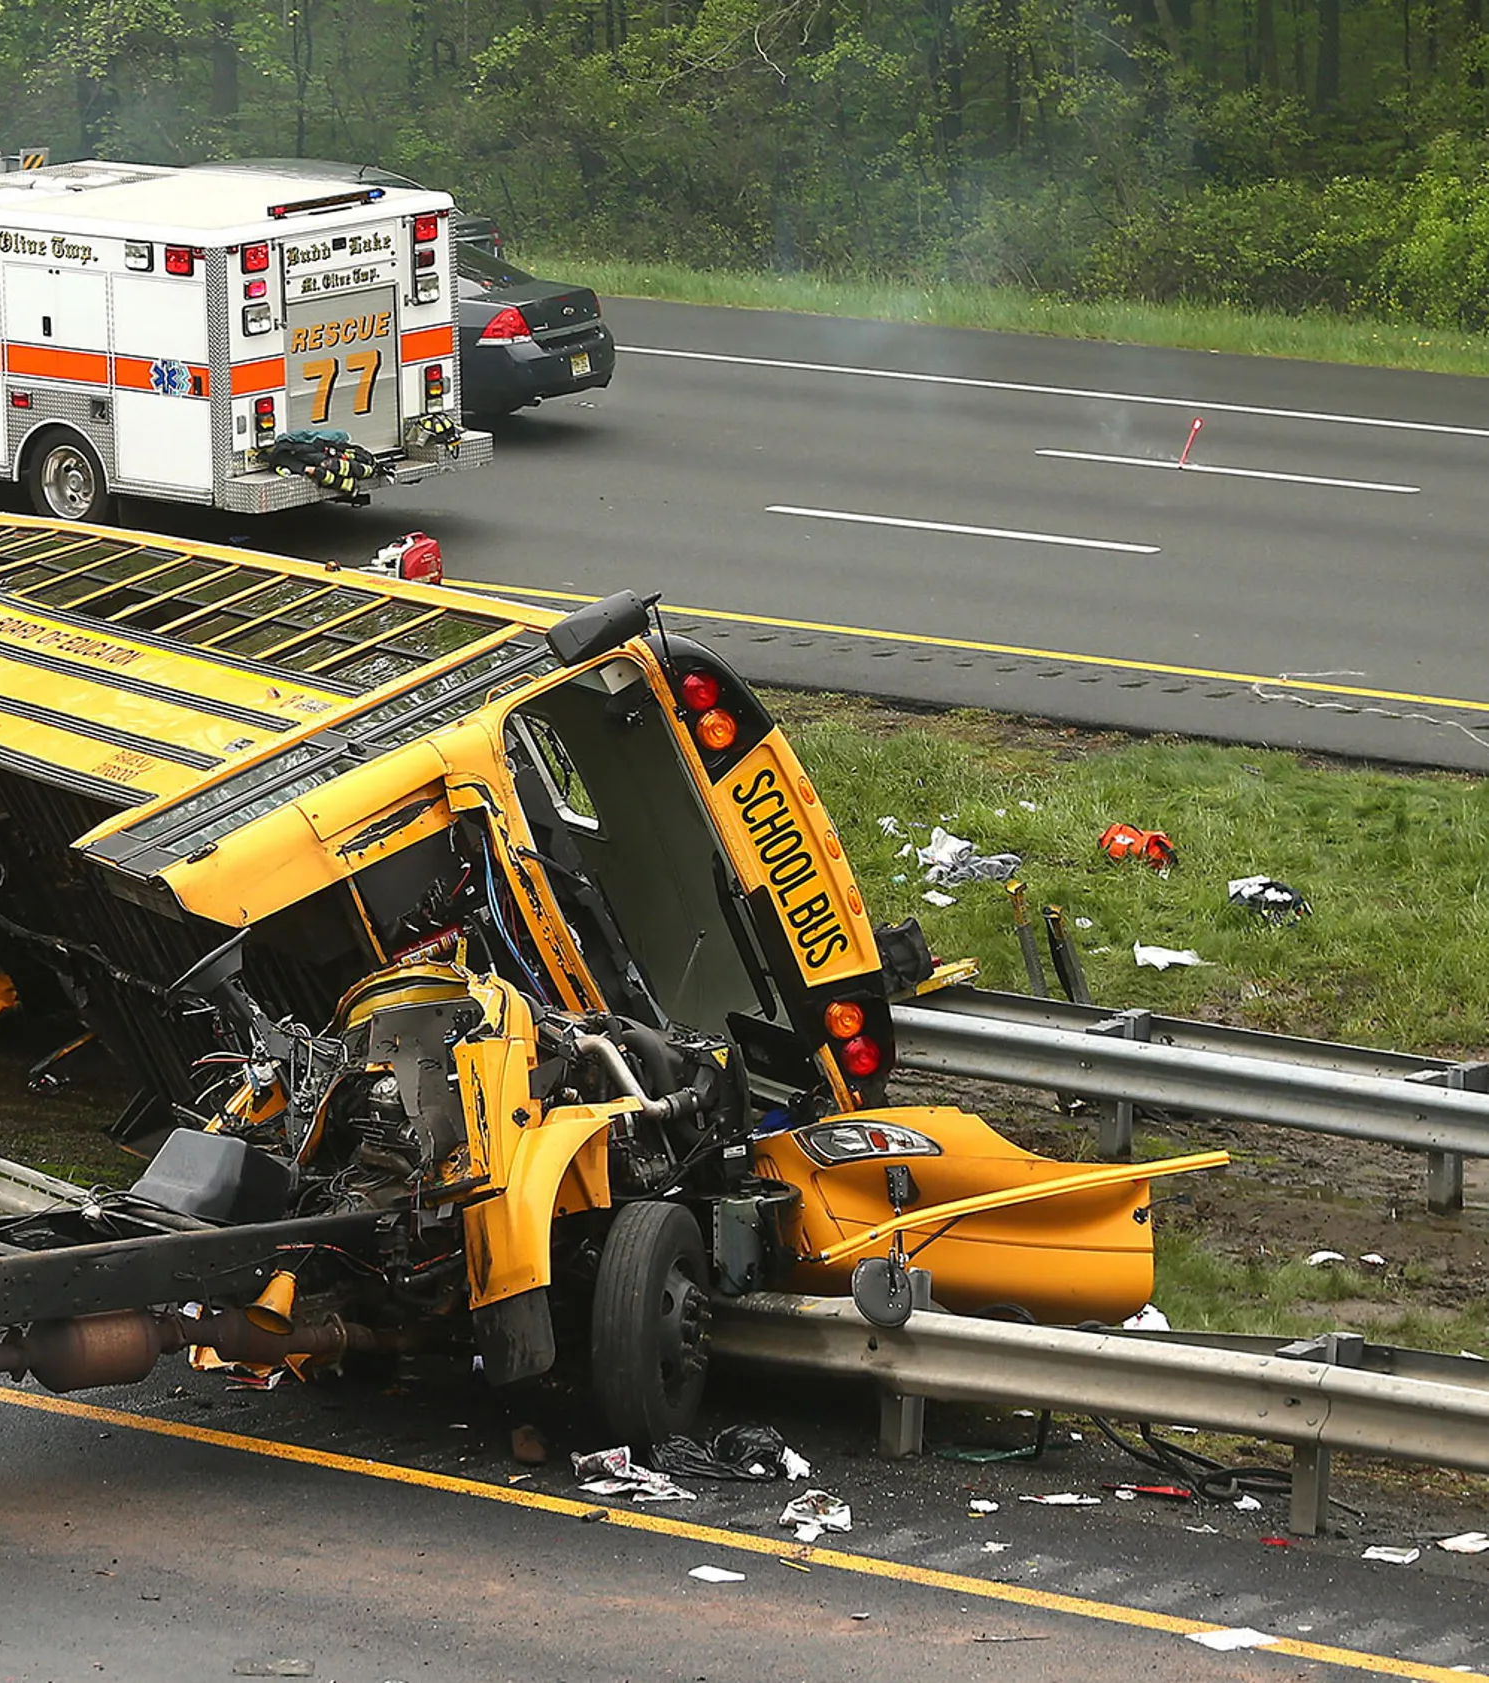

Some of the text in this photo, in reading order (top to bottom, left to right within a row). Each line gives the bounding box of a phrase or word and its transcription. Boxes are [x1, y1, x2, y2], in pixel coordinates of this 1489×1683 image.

[51, 236, 99, 265] Twp.
[286, 232, 392, 267] Budd Lake
[300, 268, 380, 294] Mt. Olive Twp.
[291, 311, 391, 354] RESCUE
[302, 349, 382, 424] 77
[36, 630, 71, 647] OF
[57, 636, 145, 667] EDUCATION
[732, 767, 849, 969] SCHOOL BUS
